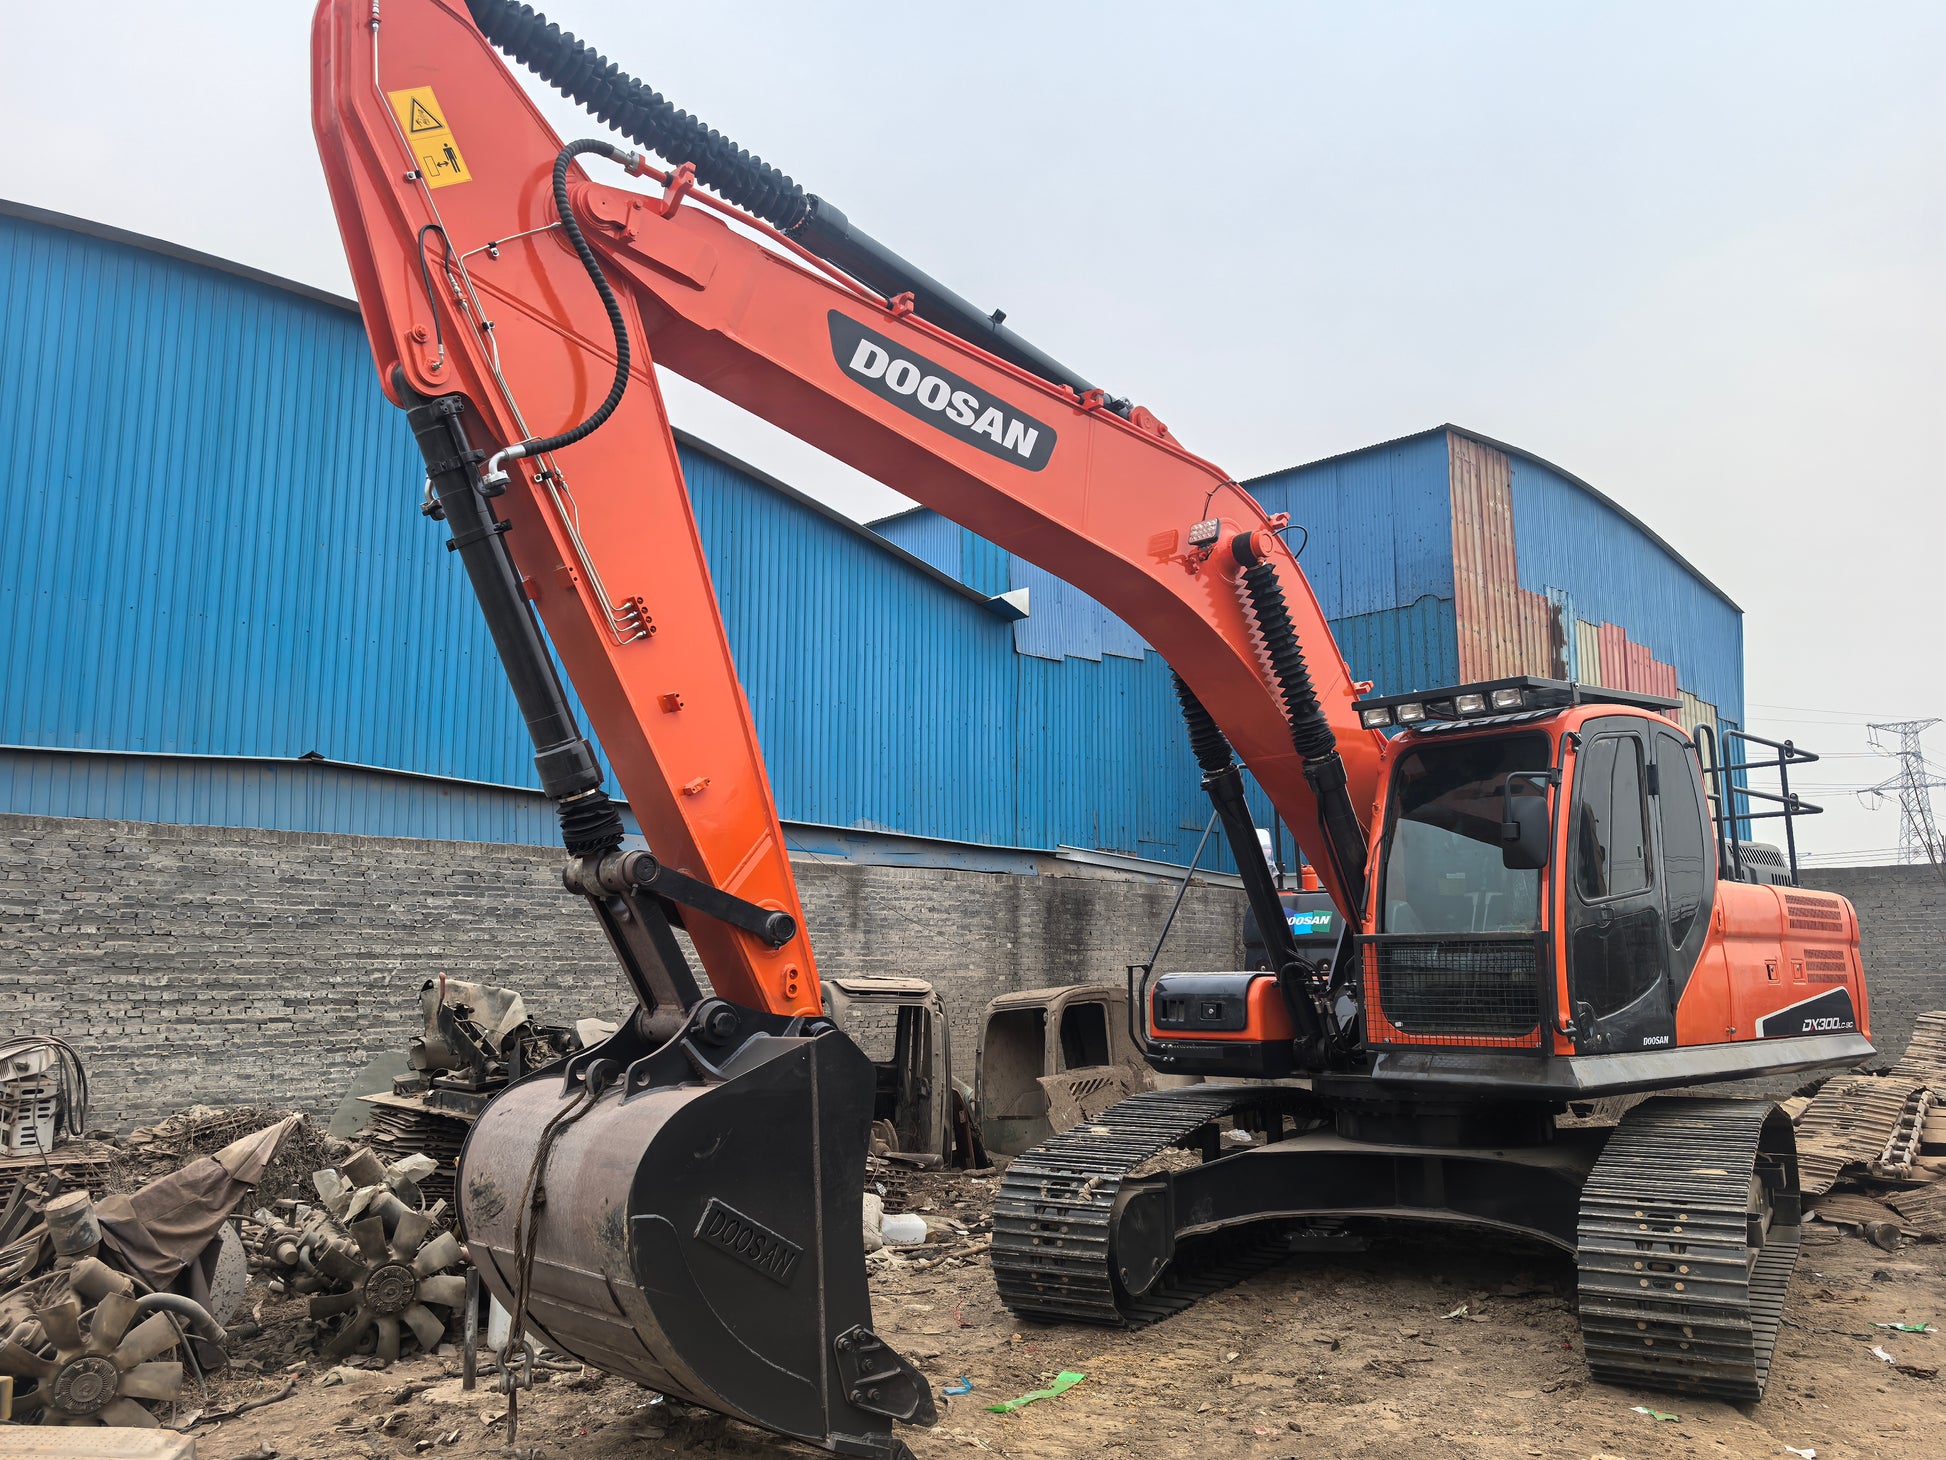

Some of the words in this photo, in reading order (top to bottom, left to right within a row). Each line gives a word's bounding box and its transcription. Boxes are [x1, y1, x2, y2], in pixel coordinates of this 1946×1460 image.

[849, 338, 1039, 458] DOOSAN
[1286, 915, 1331, 925] OOSAN
[1643, 1036, 1669, 1045] DOOSAN
[706, 1210, 796, 1278] DOOSAN
